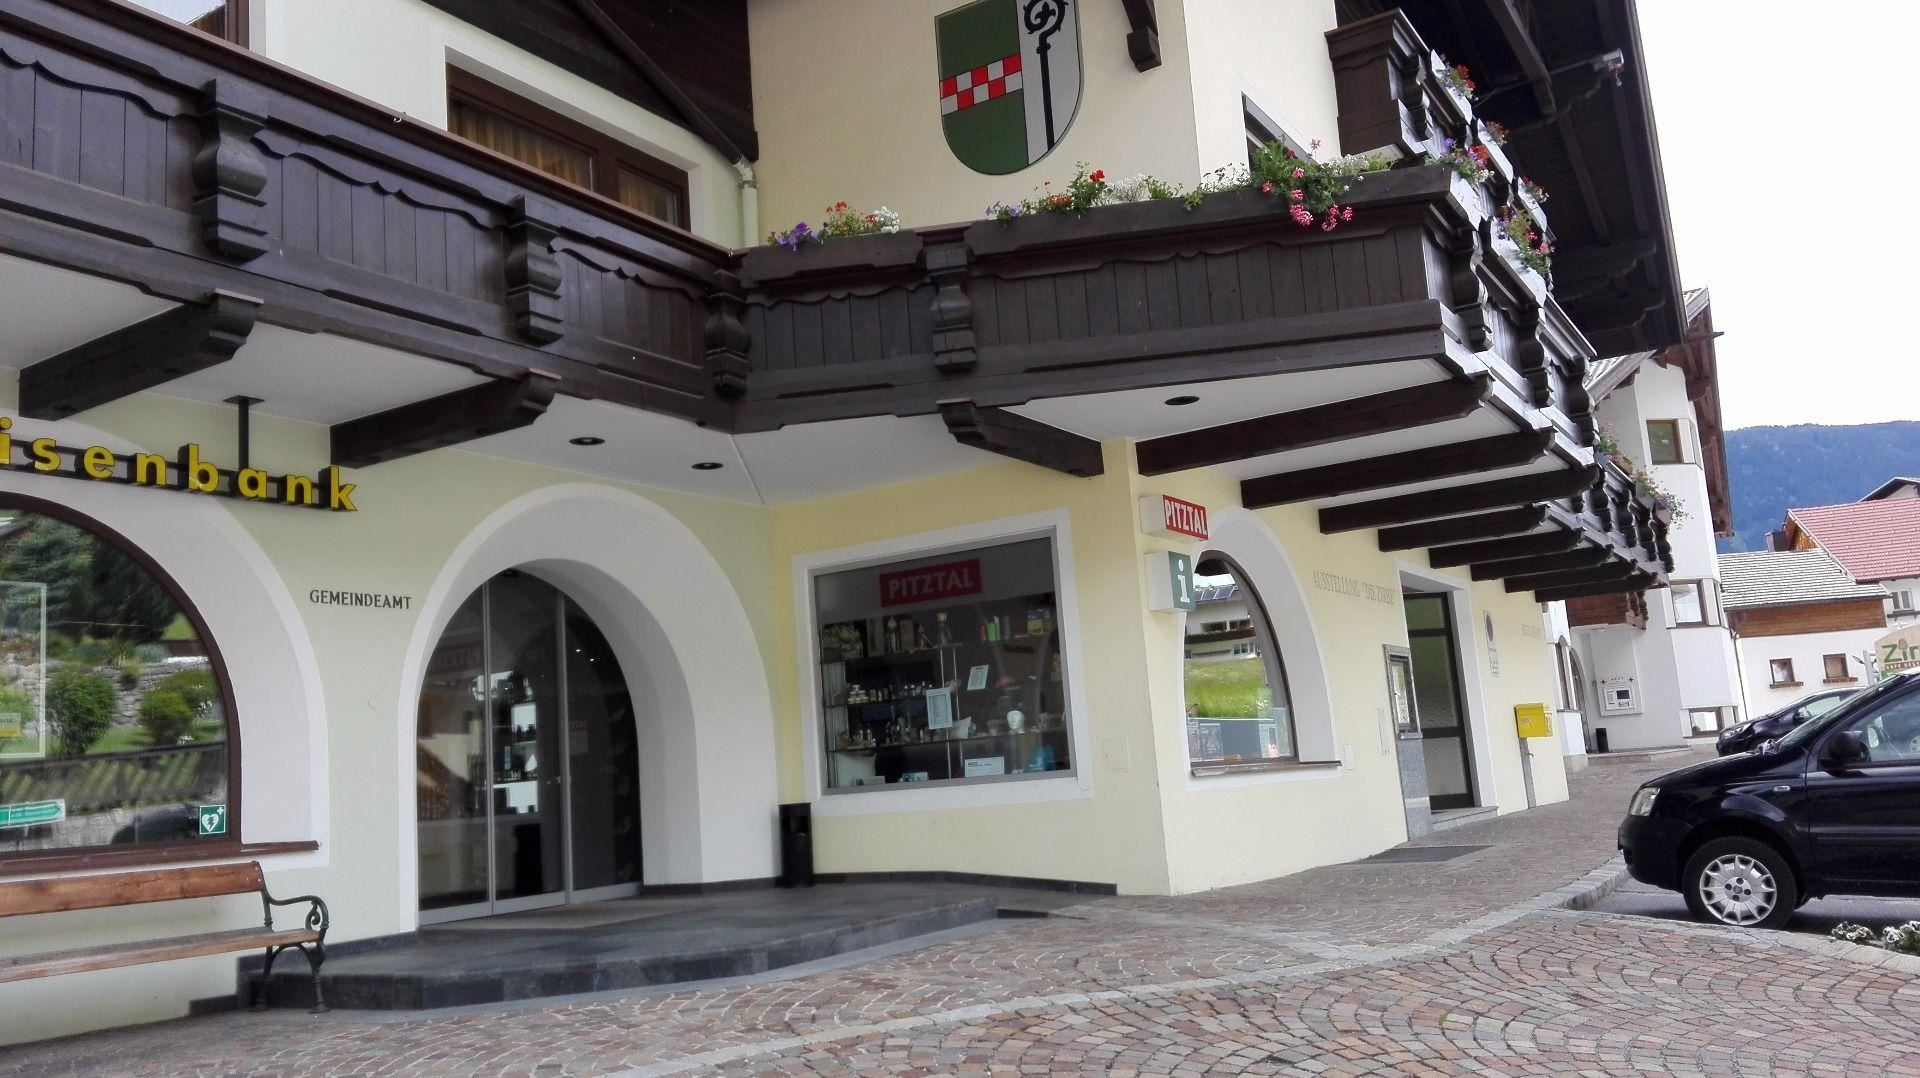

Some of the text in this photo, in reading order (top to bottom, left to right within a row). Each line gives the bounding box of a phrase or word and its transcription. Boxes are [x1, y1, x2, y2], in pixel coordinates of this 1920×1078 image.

[1164, 499, 1208, 536] PITZTAL
[309, 589, 412, 610] GEMEINDEAMT
[888, 567, 975, 600] PITZTAL
